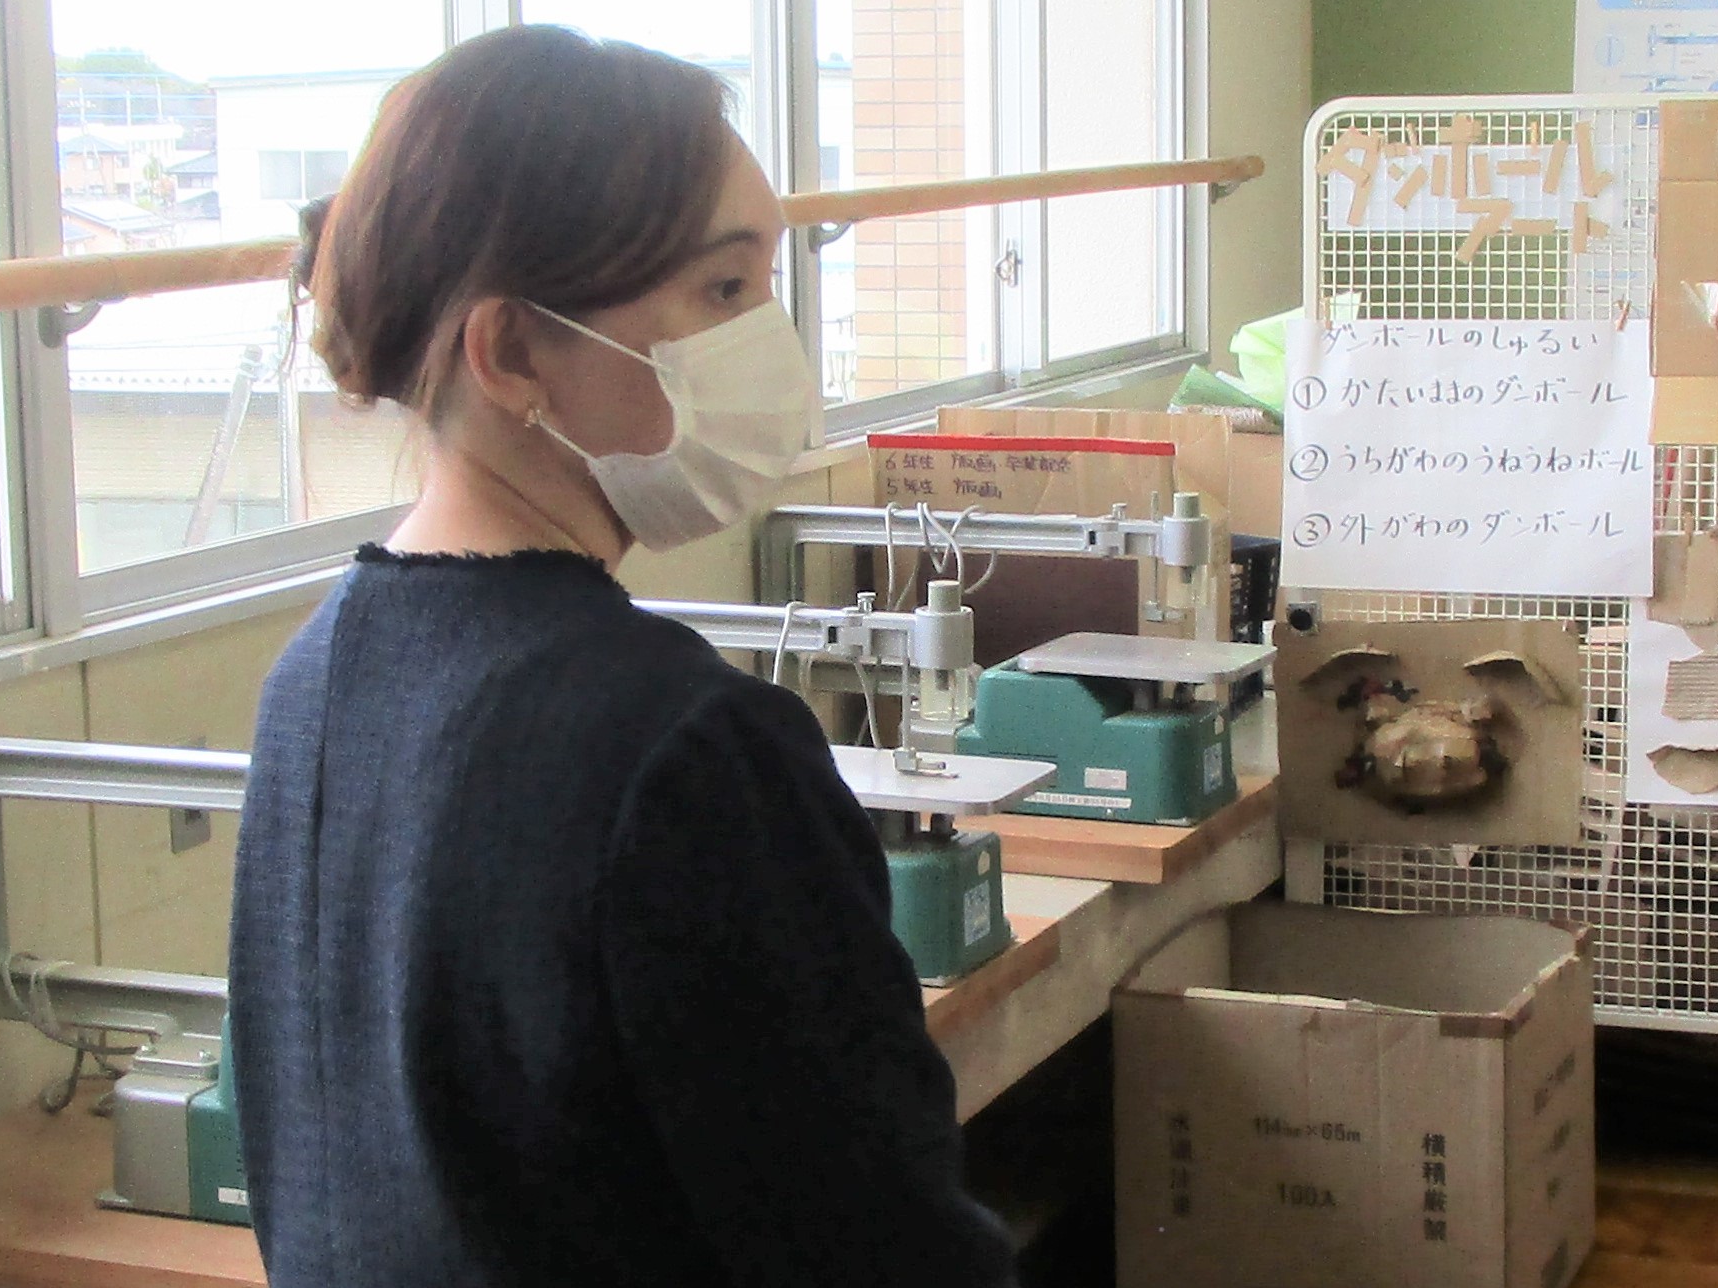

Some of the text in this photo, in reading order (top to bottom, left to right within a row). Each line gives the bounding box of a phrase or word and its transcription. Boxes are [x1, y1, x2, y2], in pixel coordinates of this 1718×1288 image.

[1455, 198, 1610, 263] アート
[1321, 323, 1599, 356] ダンボールのしゅるい
